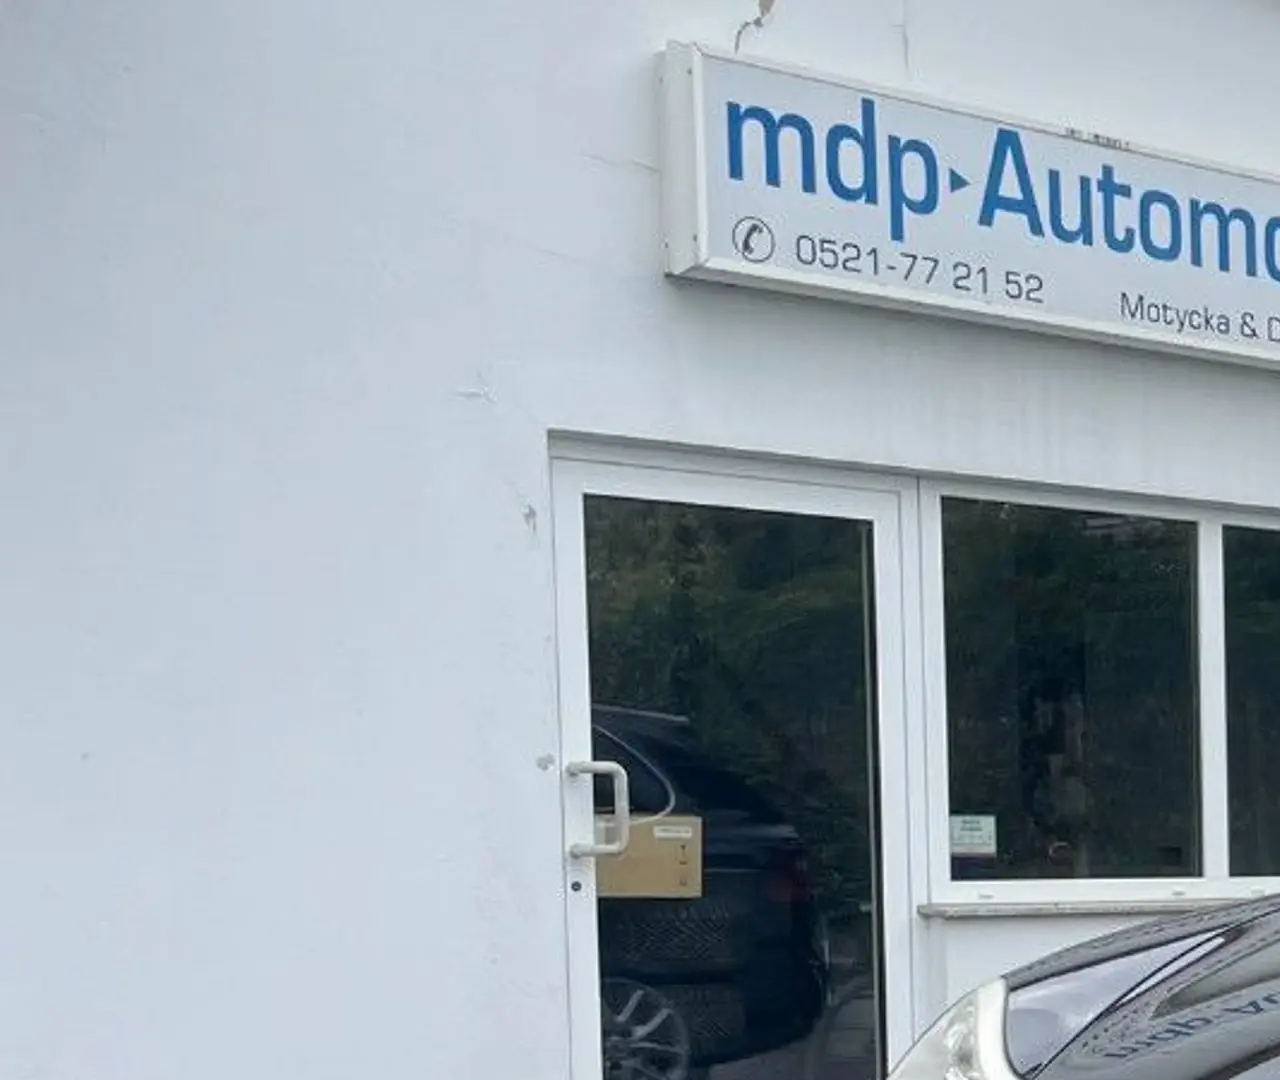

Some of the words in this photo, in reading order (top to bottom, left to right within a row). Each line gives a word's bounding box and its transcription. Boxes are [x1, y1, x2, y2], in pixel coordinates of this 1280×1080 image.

[795, 233, 940, 285] 0521-77
[952, 262, 988, 295] 21
[1005, 270, 1044, 304] 52
[1120, 291, 1231, 335] Motycka
[1239, 311, 1260, 340] &
